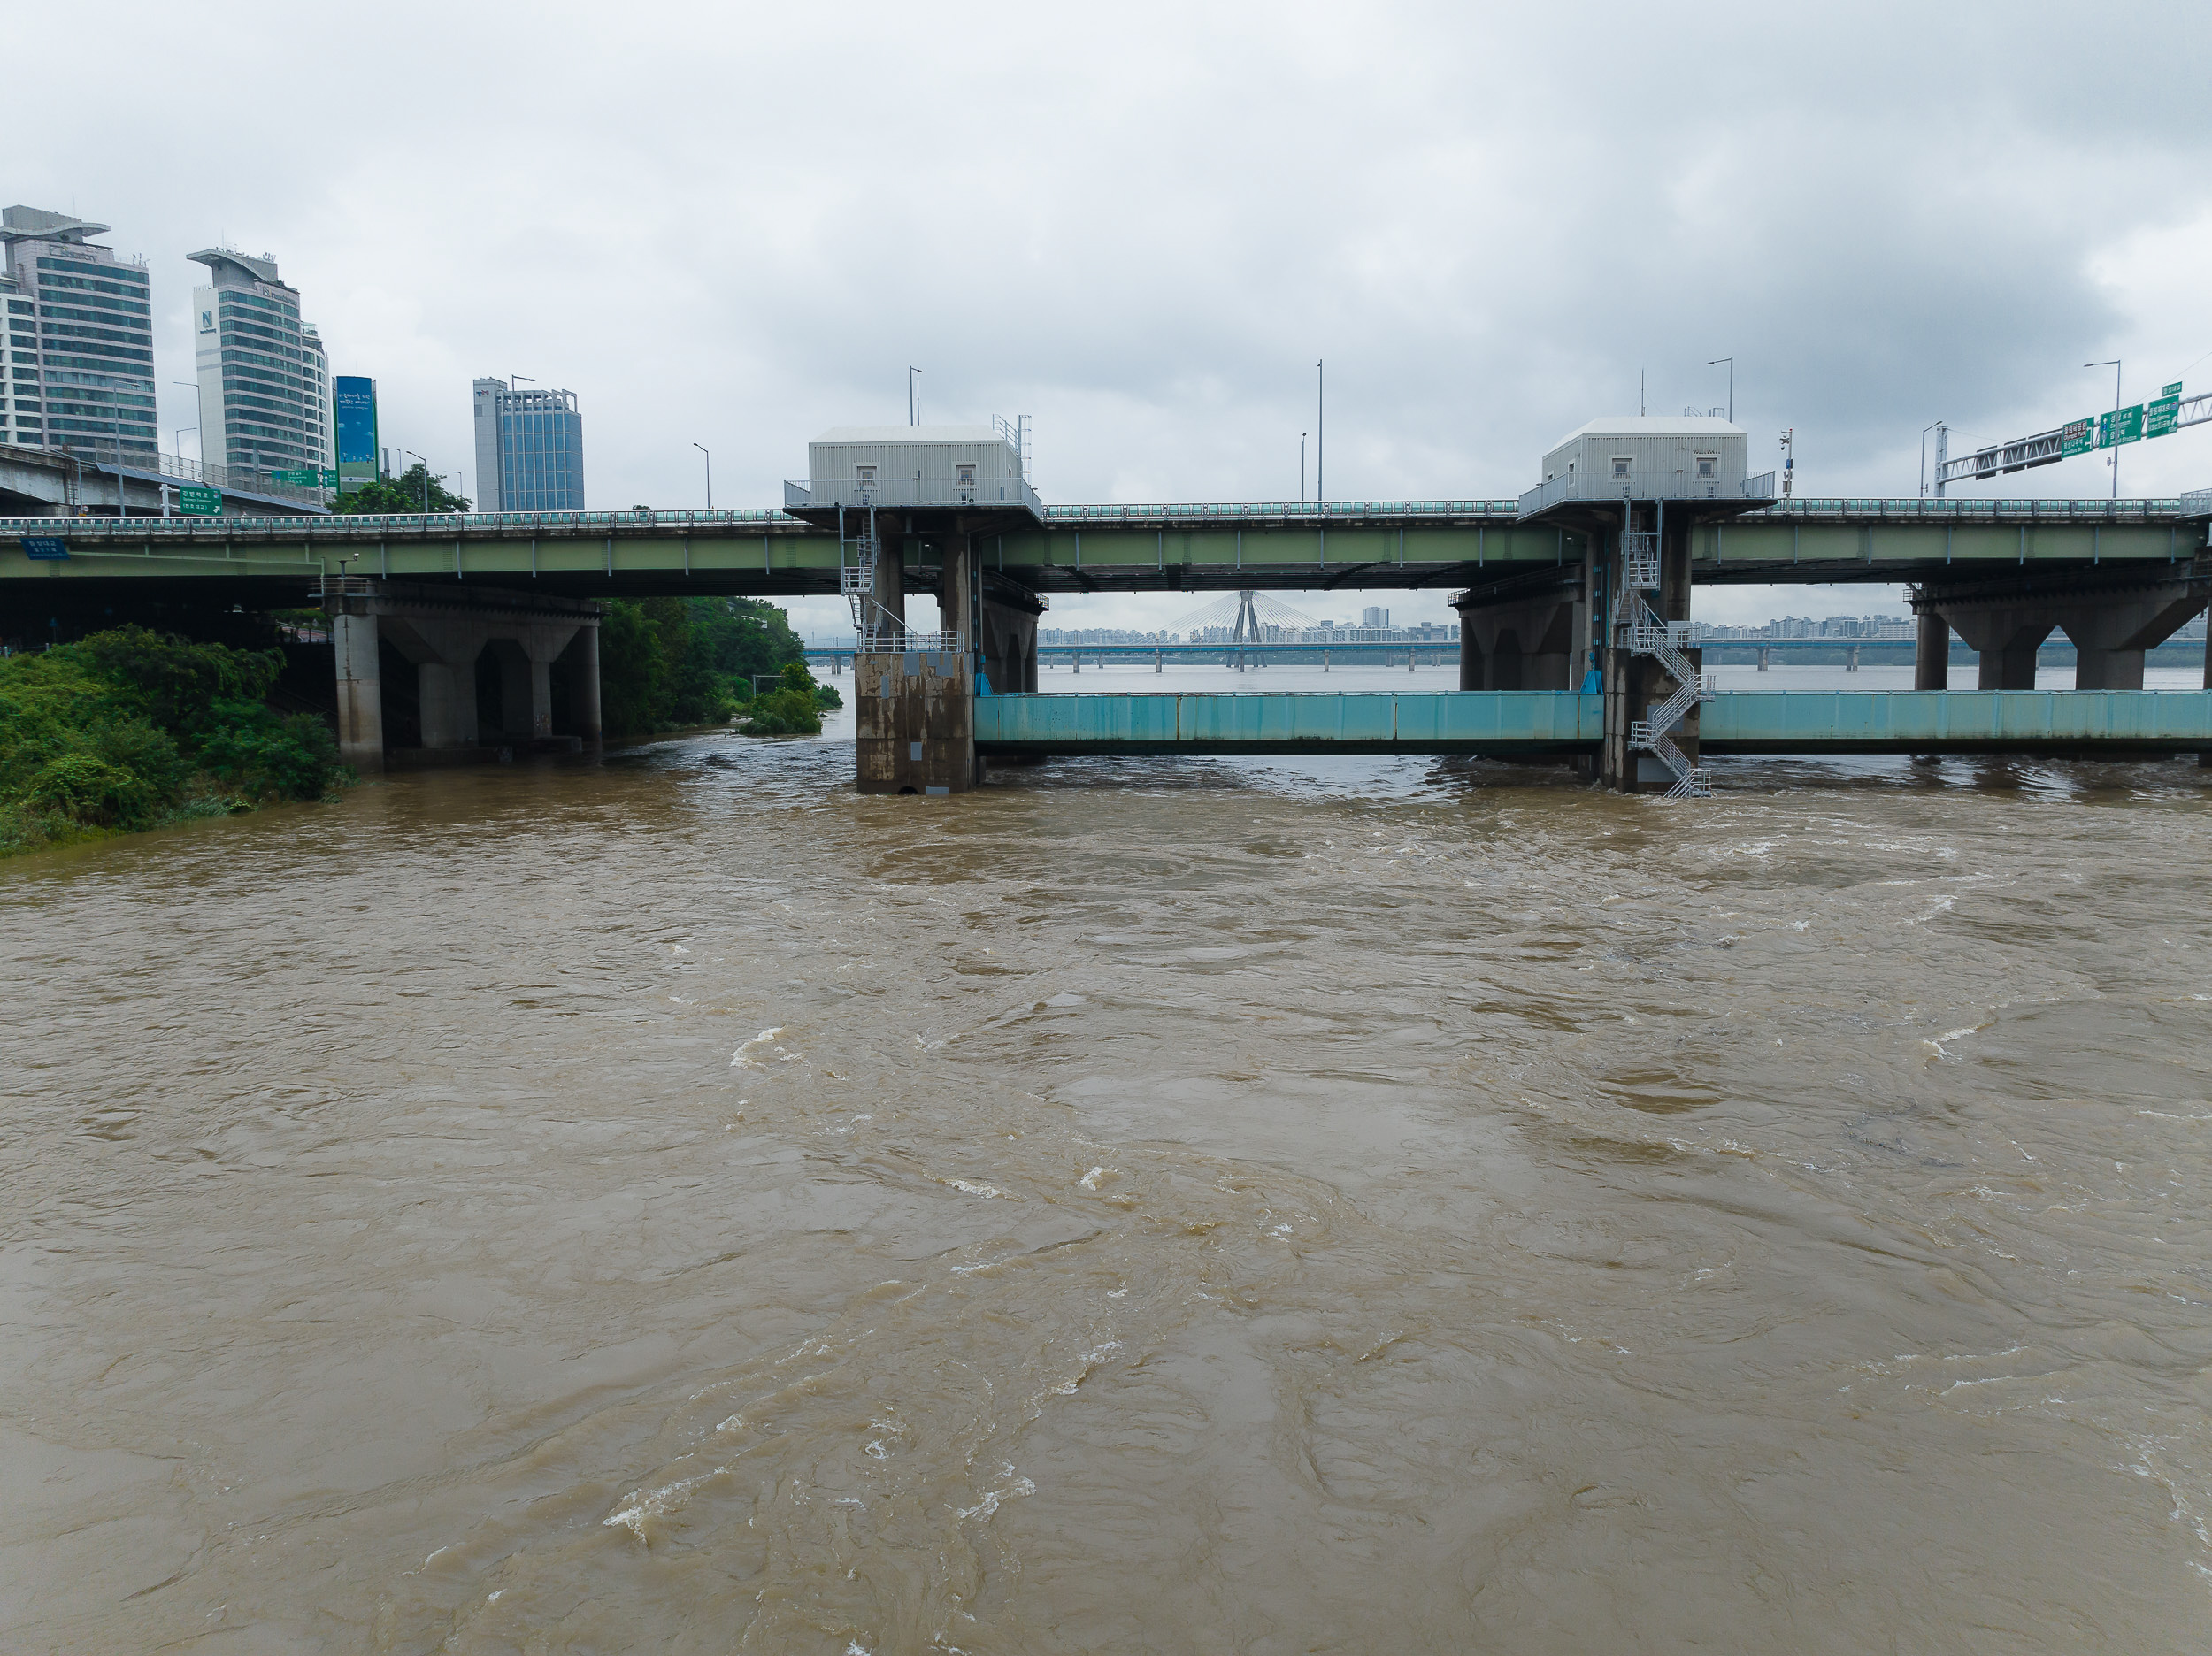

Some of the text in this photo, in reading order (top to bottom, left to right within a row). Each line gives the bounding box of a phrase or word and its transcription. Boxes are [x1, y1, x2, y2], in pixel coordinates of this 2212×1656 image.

[2063, 420, 2087, 435] 올림픽공원
[2063, 433, 2078, 441] Olympic
[182, 490, 209, 499] 강변북로
